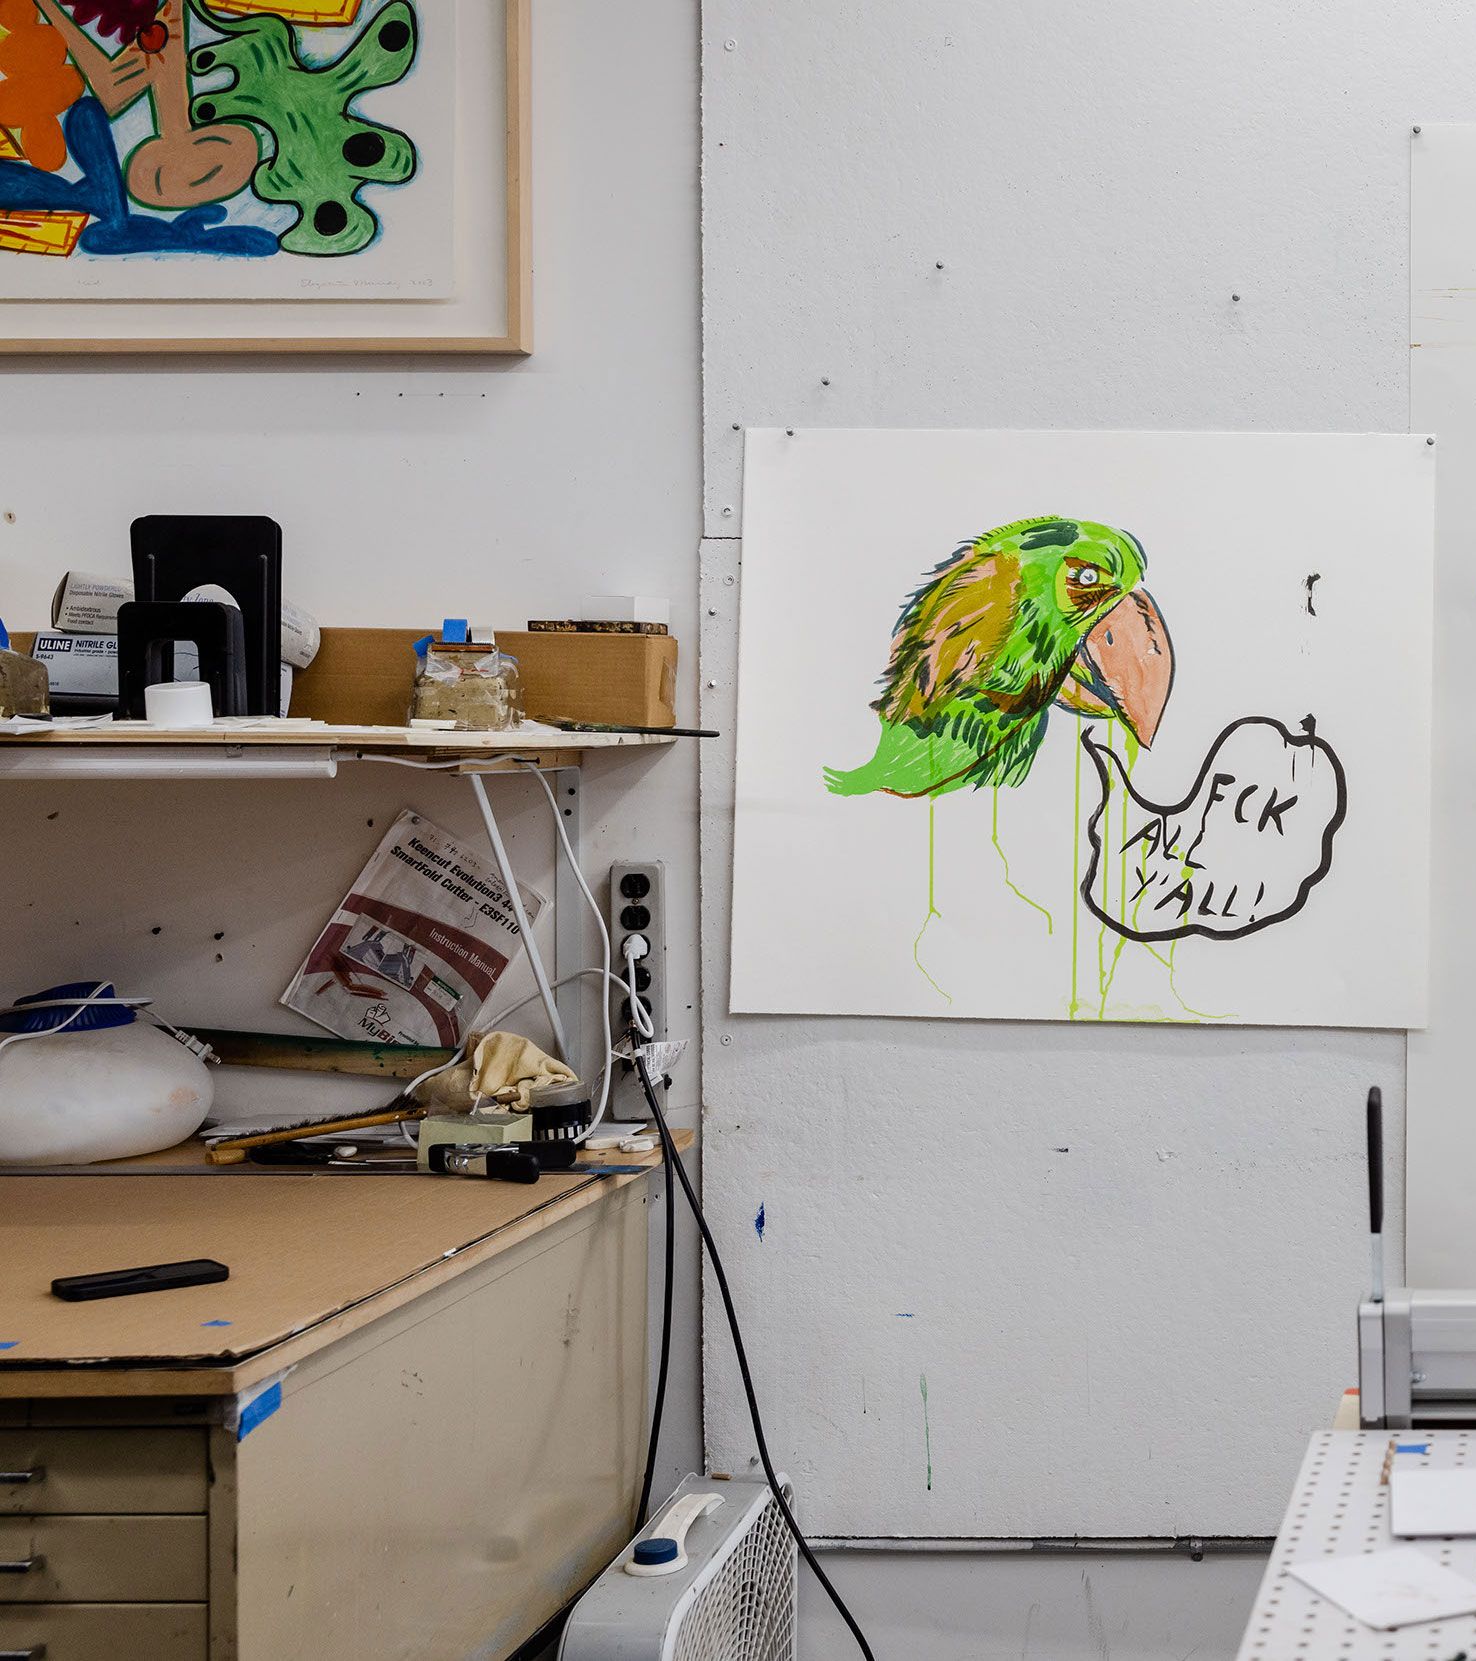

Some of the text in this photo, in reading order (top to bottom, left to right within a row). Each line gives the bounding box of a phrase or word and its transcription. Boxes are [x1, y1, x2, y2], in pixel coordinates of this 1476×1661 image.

[40, 640, 71, 650] ULINE
[76, 640, 104, 648] NITRILE
[1201, 774, 1299, 836] FCK
[408, 838, 452, 870] Keencut
[450, 865, 502, 902] Evolution3
[1119, 817, 1207, 871] ALL
[391, 846, 442, 882] SmartFold
[441, 878, 474, 904] Cutter
[478, 903, 520, 936] E3SF110
[1129, 866, 1265, 923] Y'ALL!
[429, 928, 496, 977] Instruction Manual
